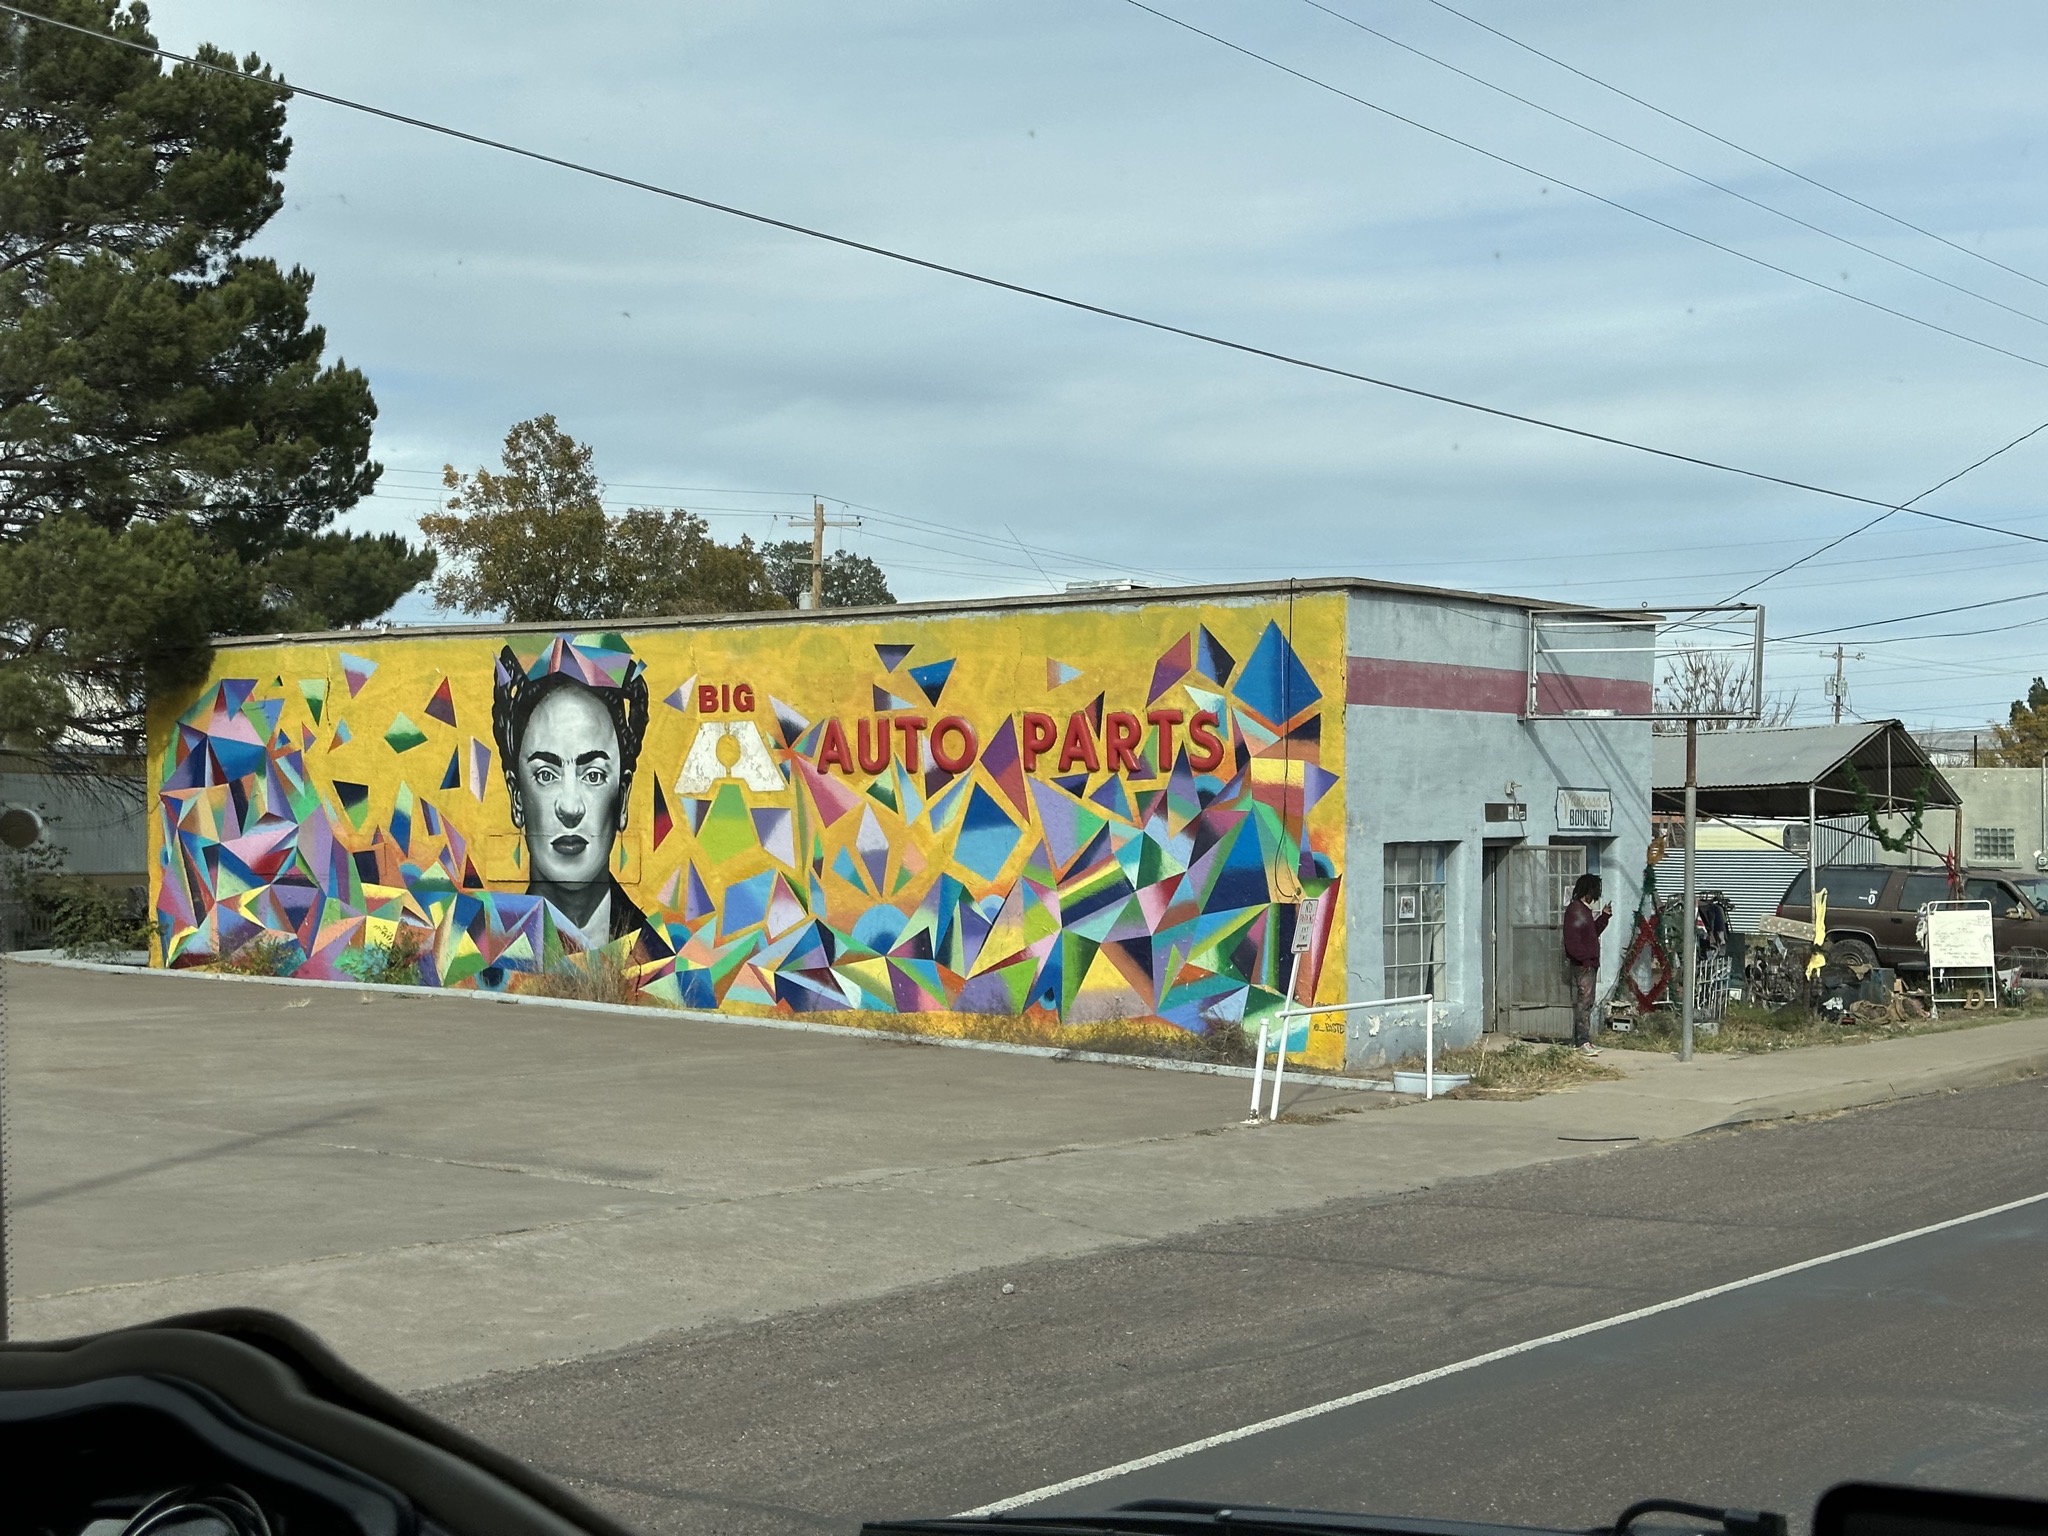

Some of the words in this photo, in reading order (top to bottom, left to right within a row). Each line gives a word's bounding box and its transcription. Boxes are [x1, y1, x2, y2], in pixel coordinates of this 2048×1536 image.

[698, 684, 755, 713] BIG
[674, 721, 788, 795] A
[817, 714, 978, 776] AUTO
[1022, 710, 1225, 775] PARTS
[1569, 808, 1608, 827] BOUTIQUE
